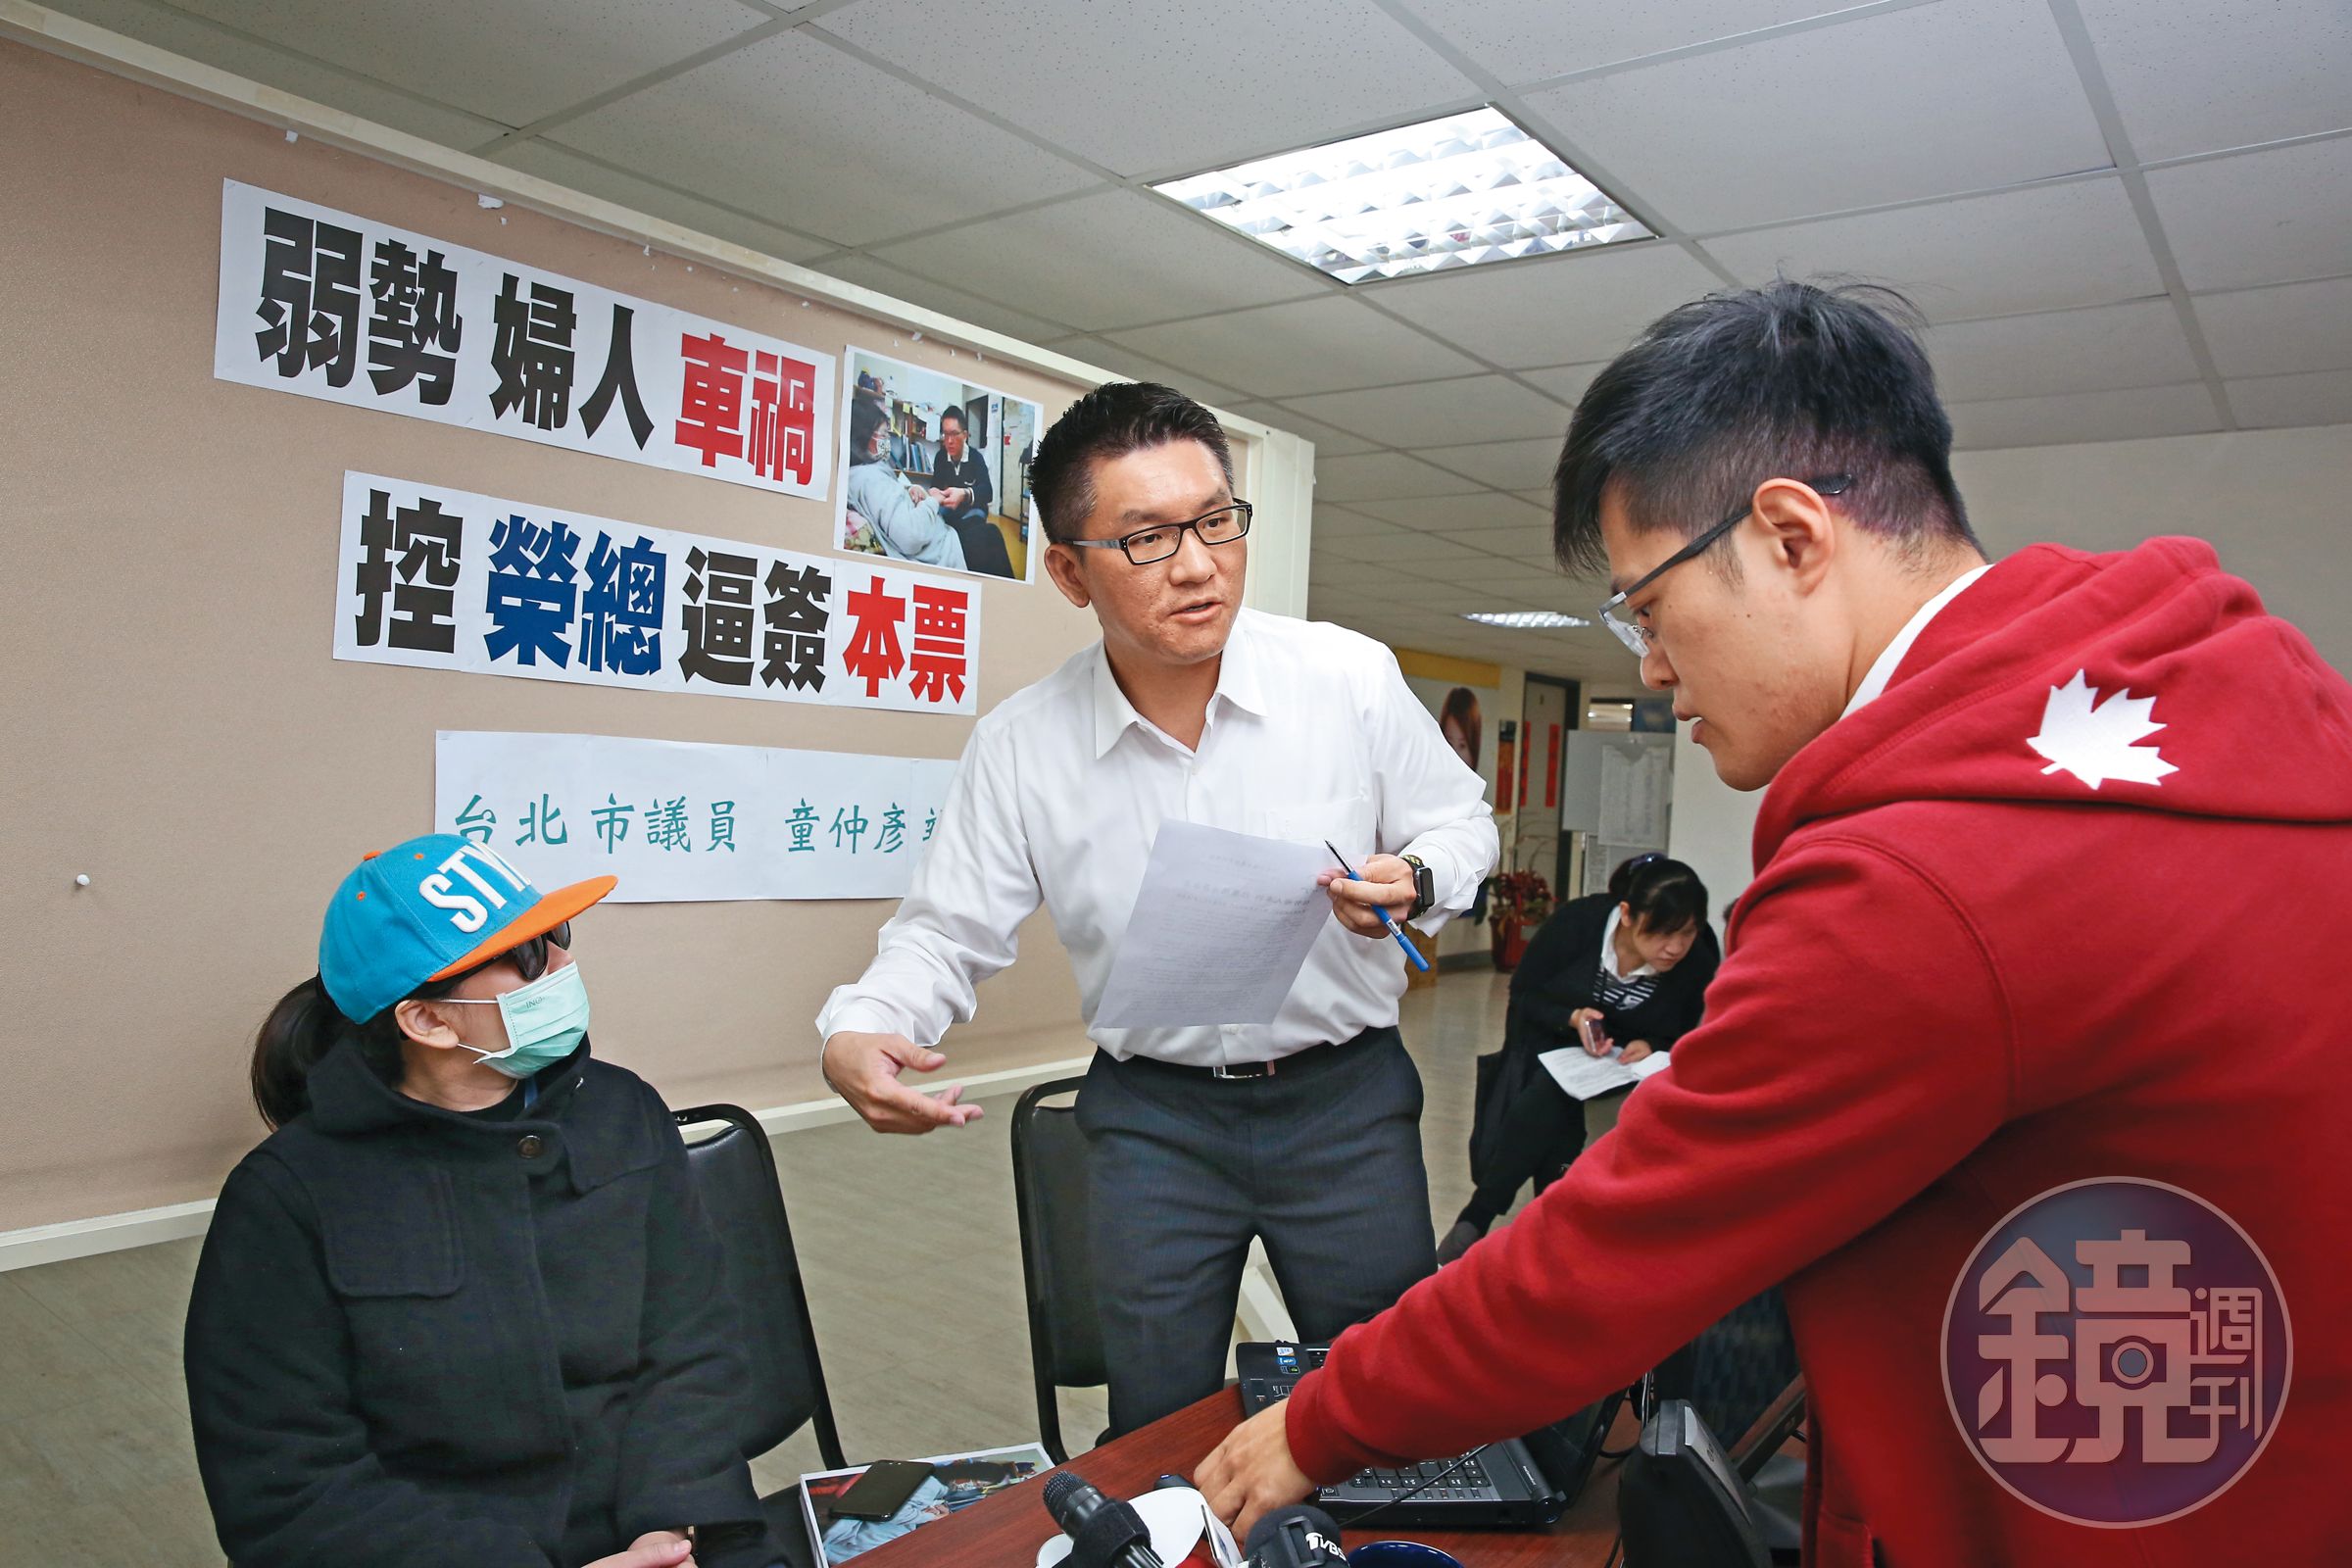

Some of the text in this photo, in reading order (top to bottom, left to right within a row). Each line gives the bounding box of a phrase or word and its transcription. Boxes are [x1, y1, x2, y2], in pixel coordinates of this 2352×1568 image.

[455, 793, 736, 854] 台北市議員
[418, 840, 532, 933] STY
